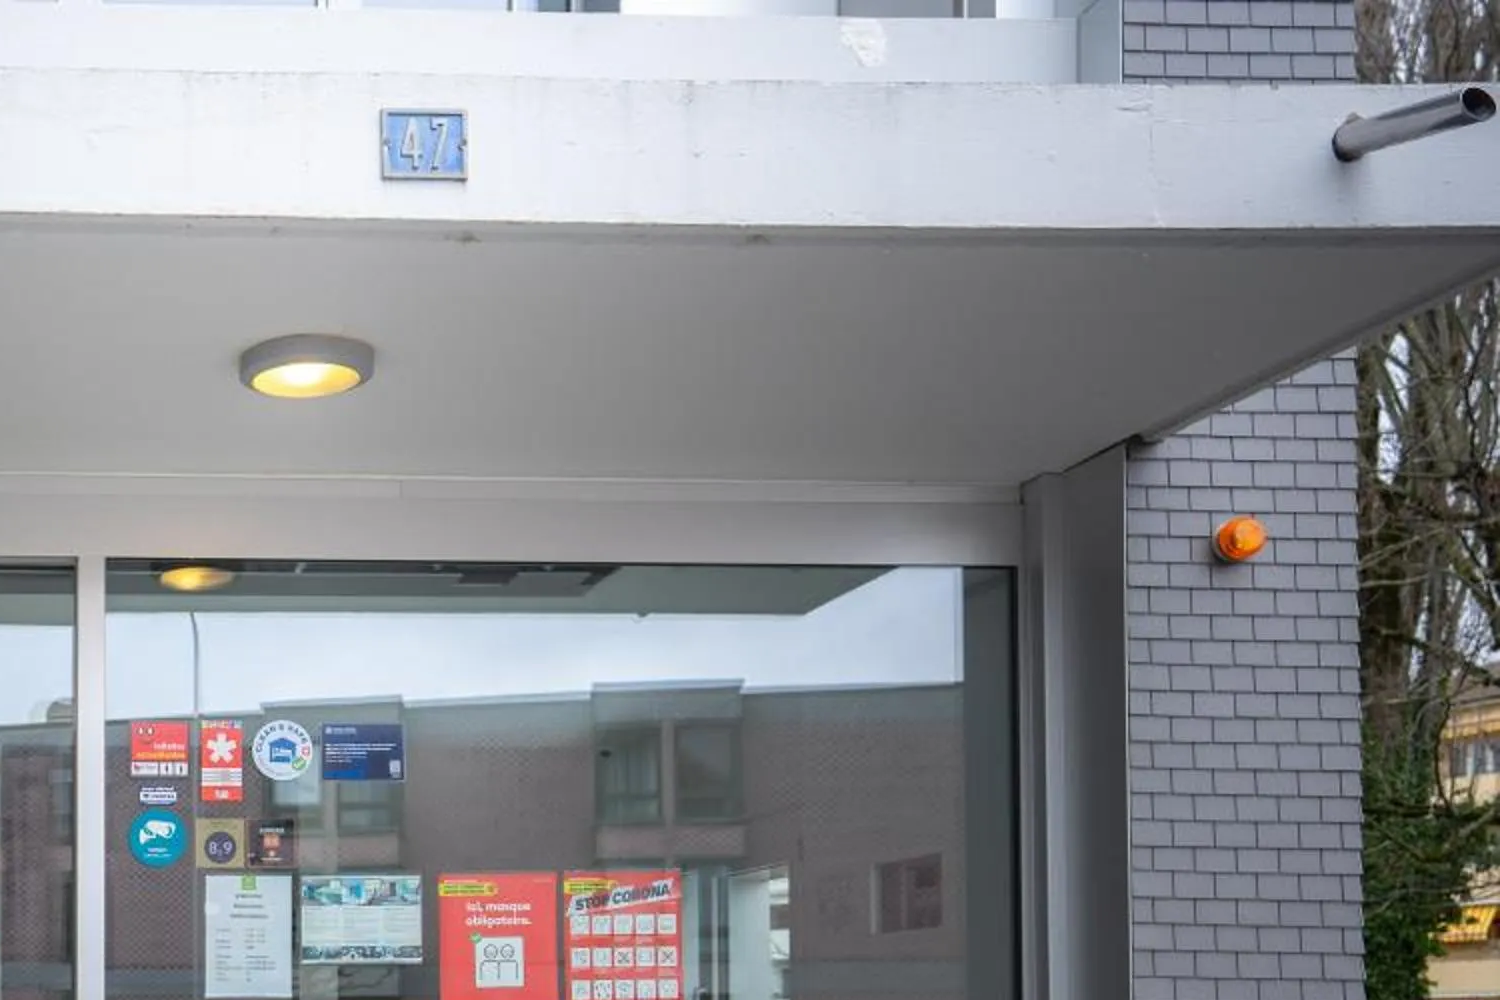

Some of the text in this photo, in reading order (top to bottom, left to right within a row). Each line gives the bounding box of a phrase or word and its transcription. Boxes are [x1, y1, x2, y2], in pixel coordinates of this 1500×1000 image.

[400, 116, 449, 171] 47
[485, 902, 531, 914] masque
[575, 883, 670, 911] STOP CORONA
